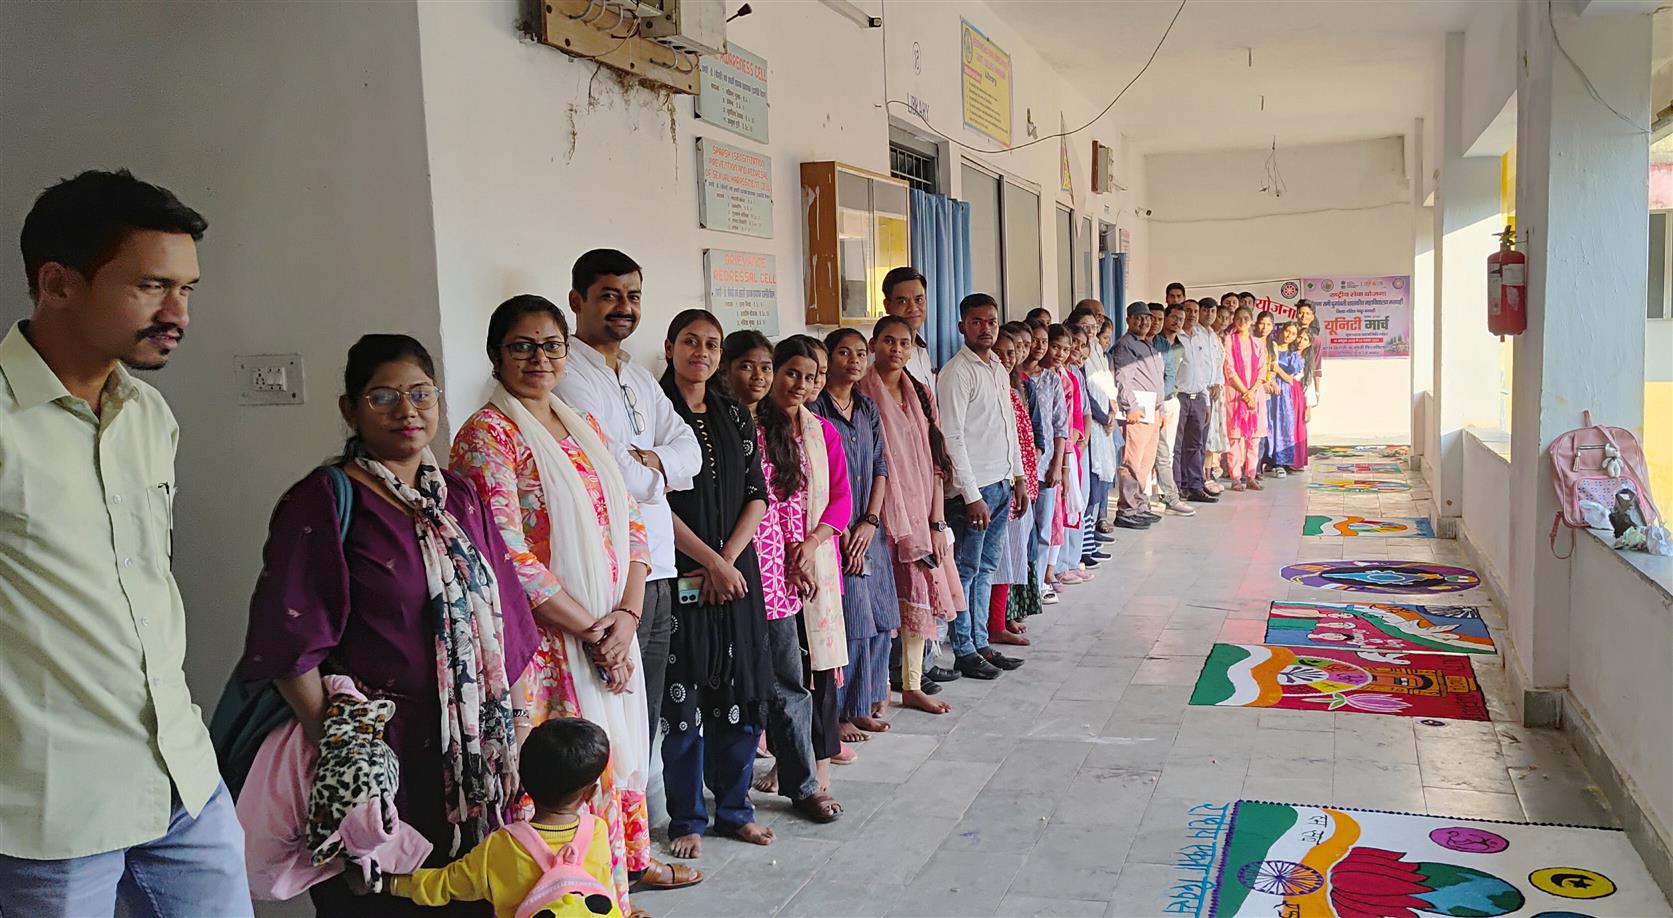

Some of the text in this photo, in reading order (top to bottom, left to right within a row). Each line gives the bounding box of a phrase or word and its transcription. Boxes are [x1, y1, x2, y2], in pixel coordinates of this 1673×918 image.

[754, 63, 768, 83] CELL
[907, 92, 930, 121] LIBRARY
[714, 269, 777, 284] REDRESSAL CELL
[1255, 296, 1297, 319] योजना
[1324, 316, 1390, 336] यूनिटी मार्च
